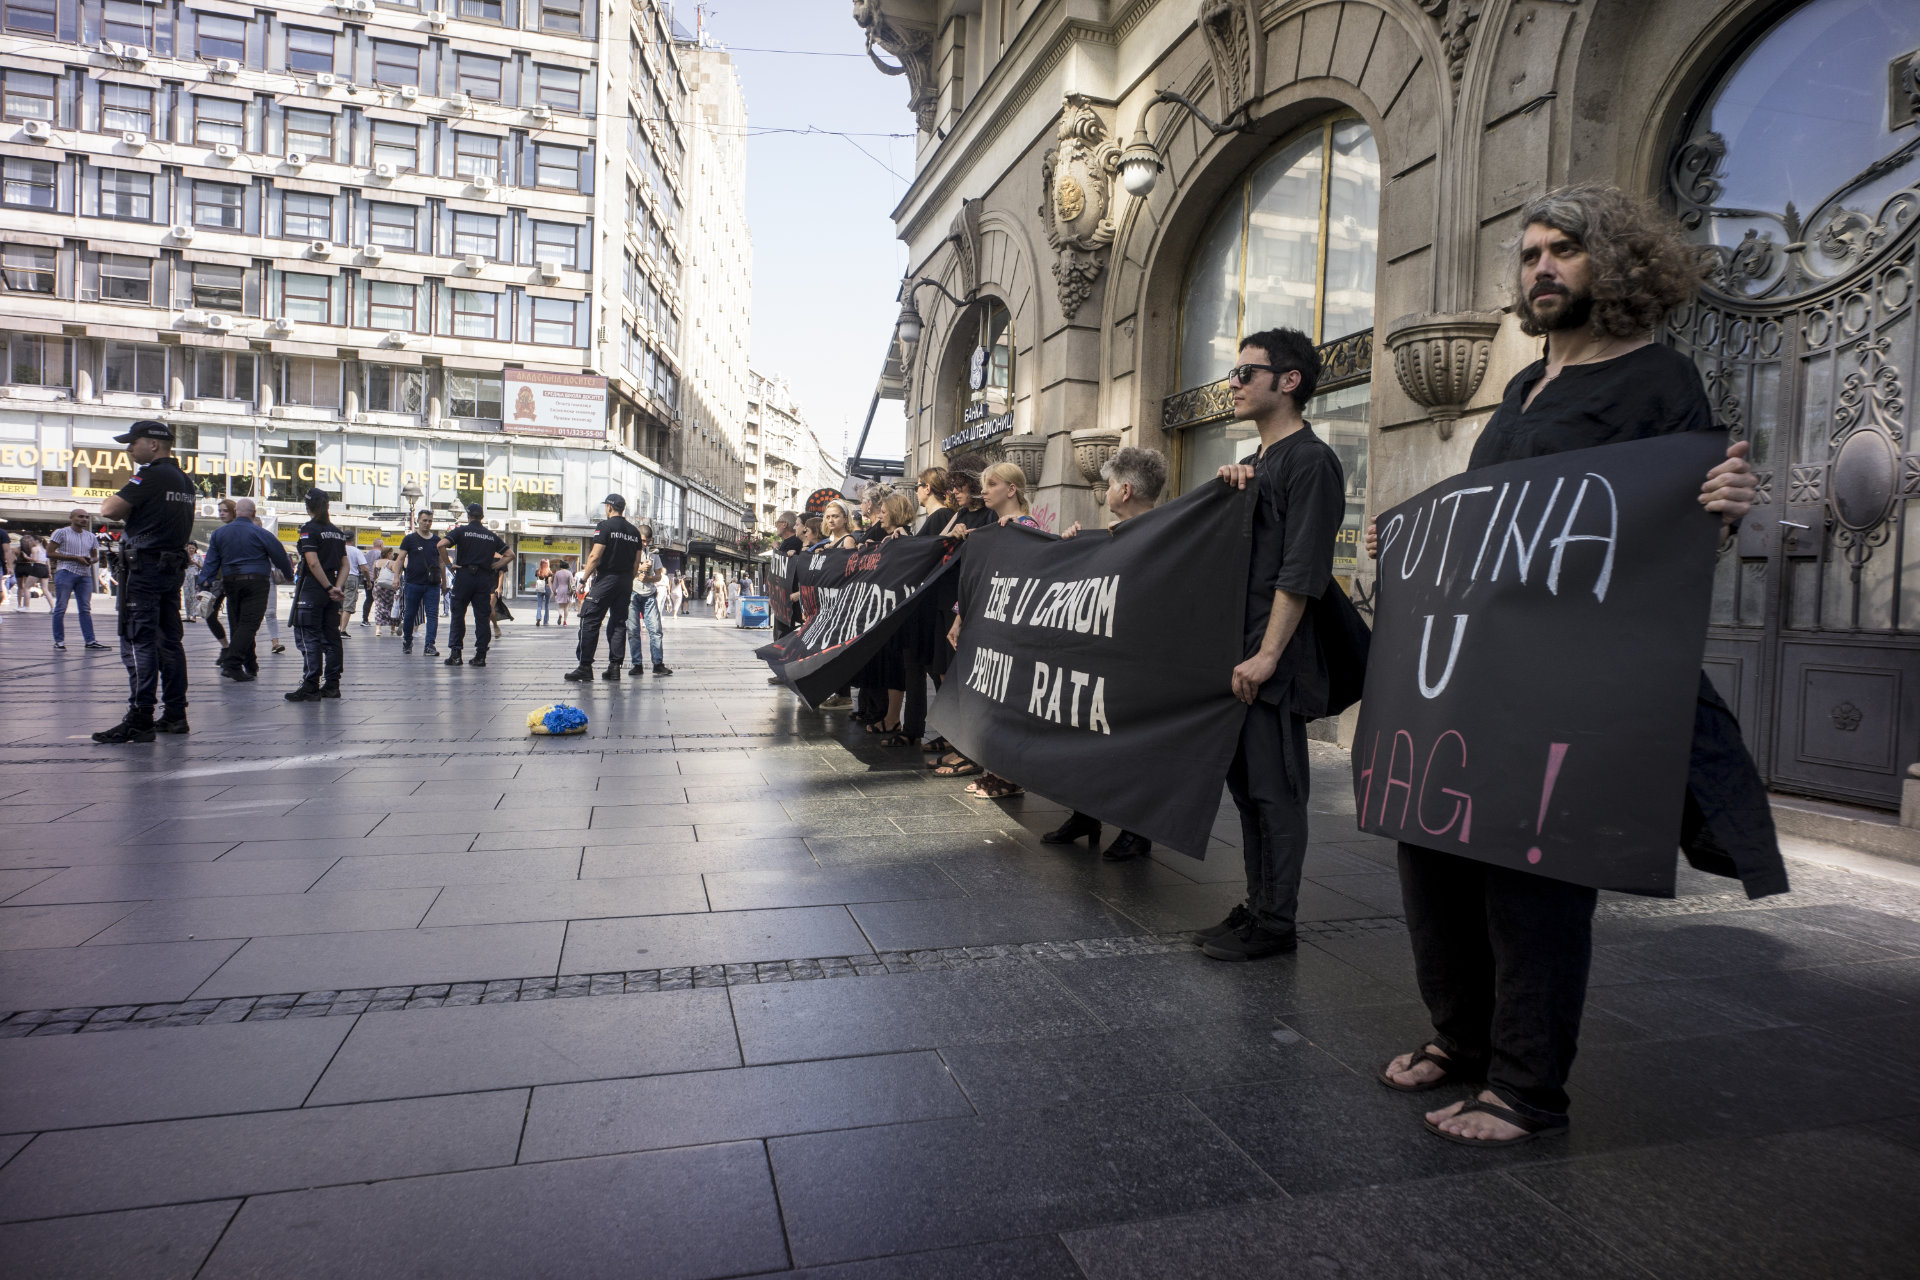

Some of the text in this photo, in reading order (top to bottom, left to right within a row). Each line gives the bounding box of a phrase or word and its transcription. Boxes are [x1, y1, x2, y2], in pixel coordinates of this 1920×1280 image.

[964, 403, 984, 423] БАНКА
[970, 412, 1014, 441] ШТЕДИОНИЦ
[170, 455, 291, 480] ULTURAL
[297, 462, 393, 486] CENTRE
[439, 472, 557, 495] BELGRADE
[1376, 472, 1618, 604] PUTINA
[1011, 577, 1041, 625] U
[1029, 574, 1120, 638] CRNOM
[1418, 613, 1470, 699] U
[965, 646, 1111, 736] PROTIV RATA
